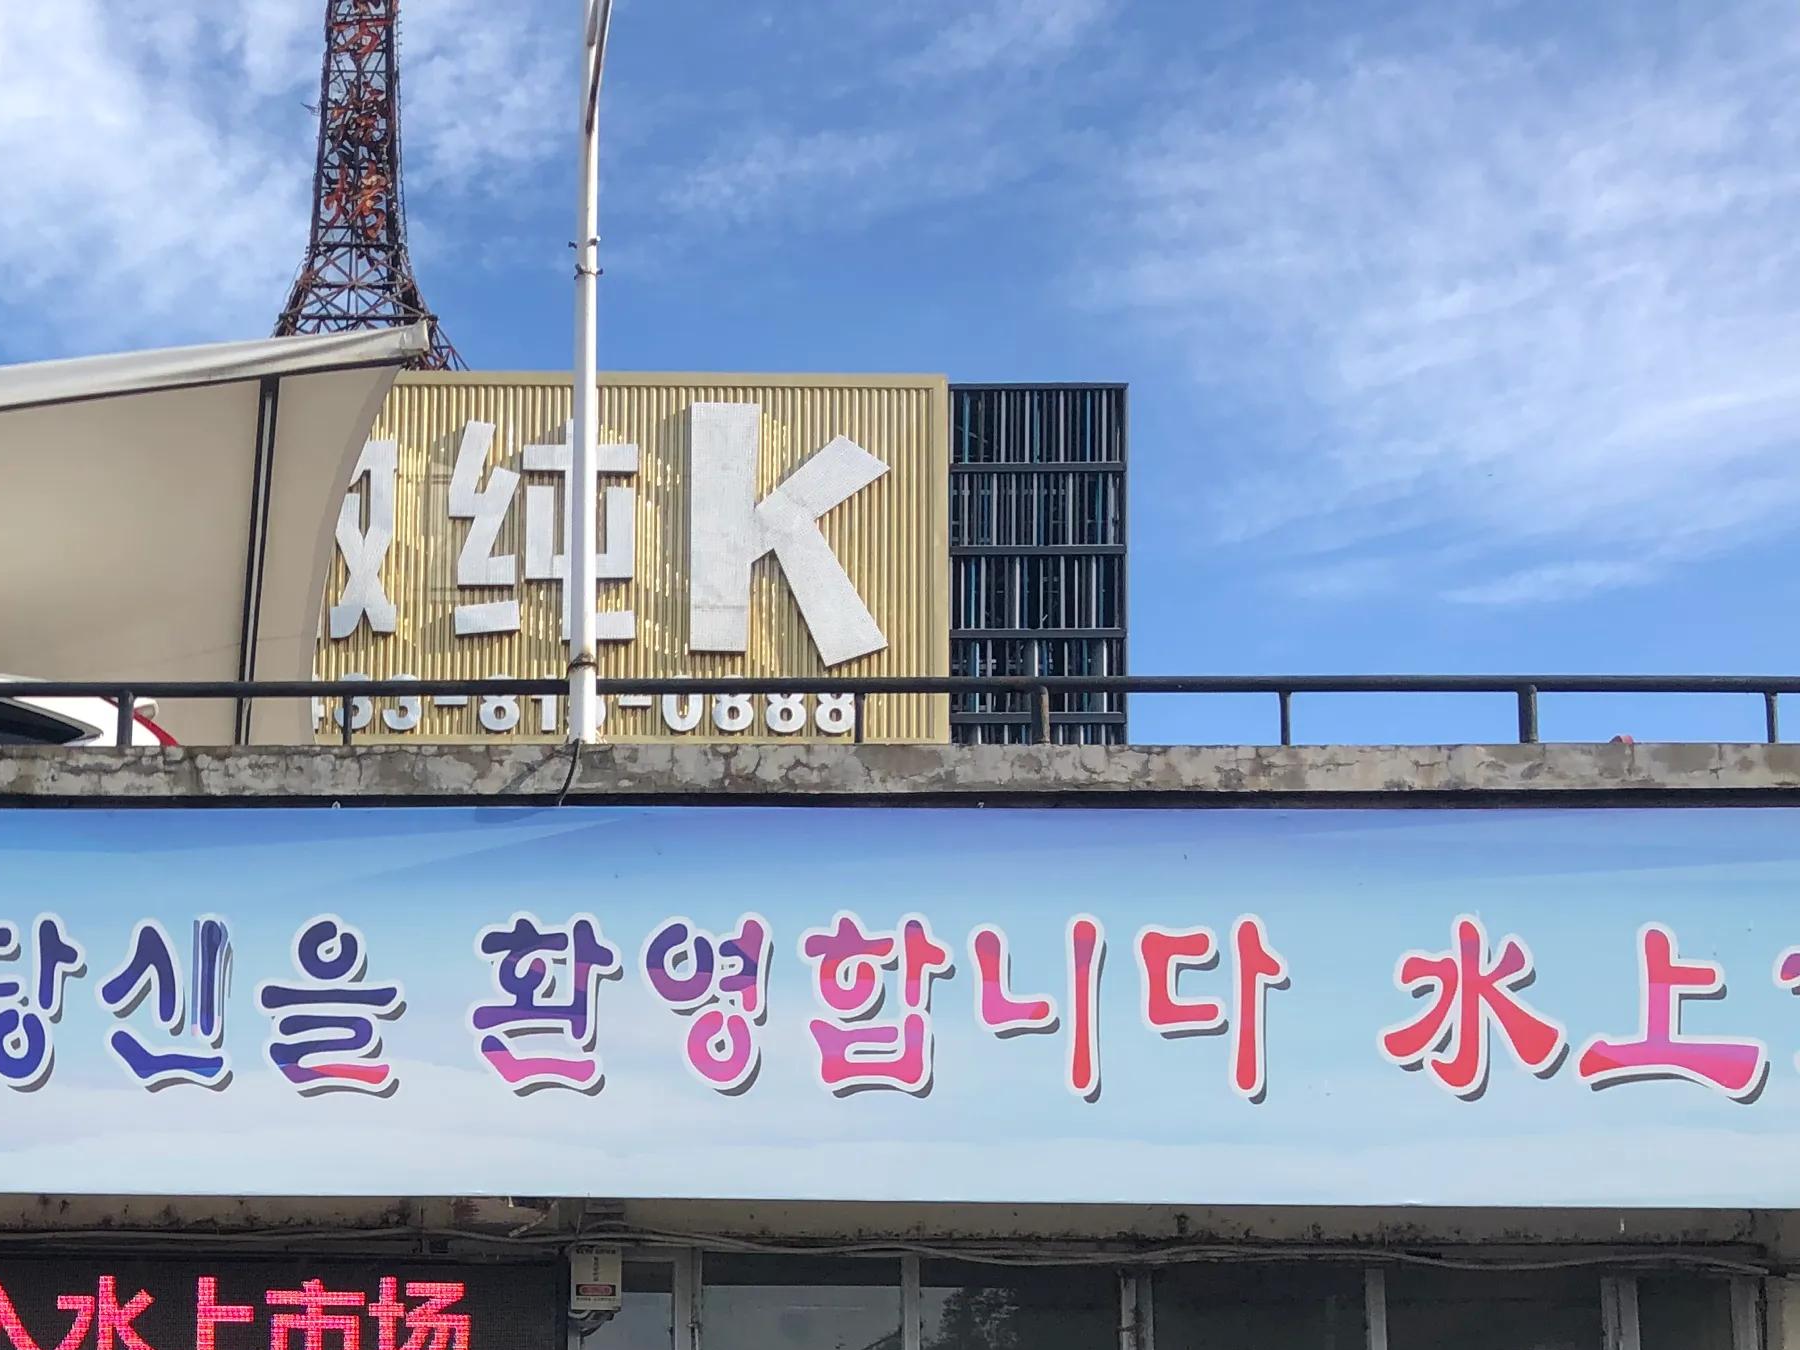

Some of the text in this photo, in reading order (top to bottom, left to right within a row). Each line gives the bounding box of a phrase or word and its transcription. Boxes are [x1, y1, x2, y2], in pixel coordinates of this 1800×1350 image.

[312, 672, 856, 734] 33-81-0888
[474, 918, 1285, 1100] 환영합니다
[1380, 916, 1800, 1098] 水上
